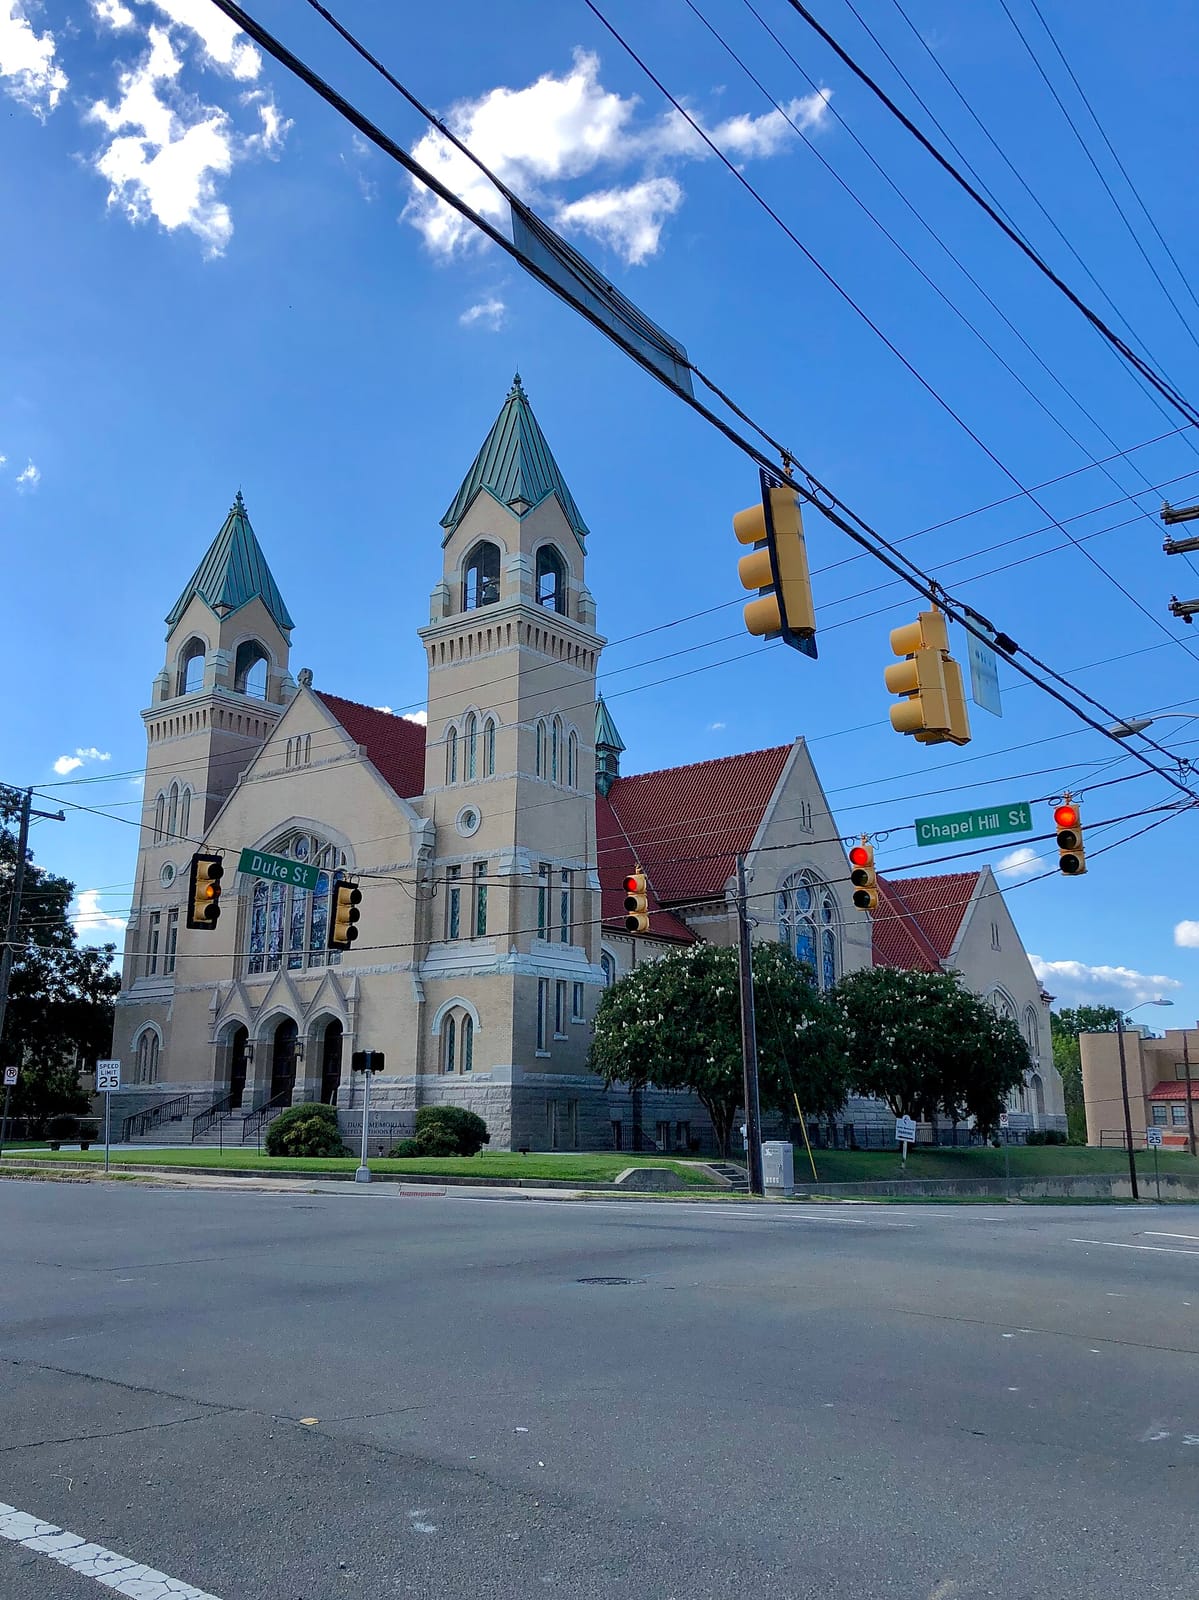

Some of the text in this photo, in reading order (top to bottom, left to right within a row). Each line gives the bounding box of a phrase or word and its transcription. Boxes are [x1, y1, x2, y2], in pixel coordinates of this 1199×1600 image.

[921, 810, 1027, 838] Chapel Hill St
[251, 855, 309, 884] Duke St
[99, 1076, 119, 1088] 25
[1149, 1136, 1161, 1144] 25
